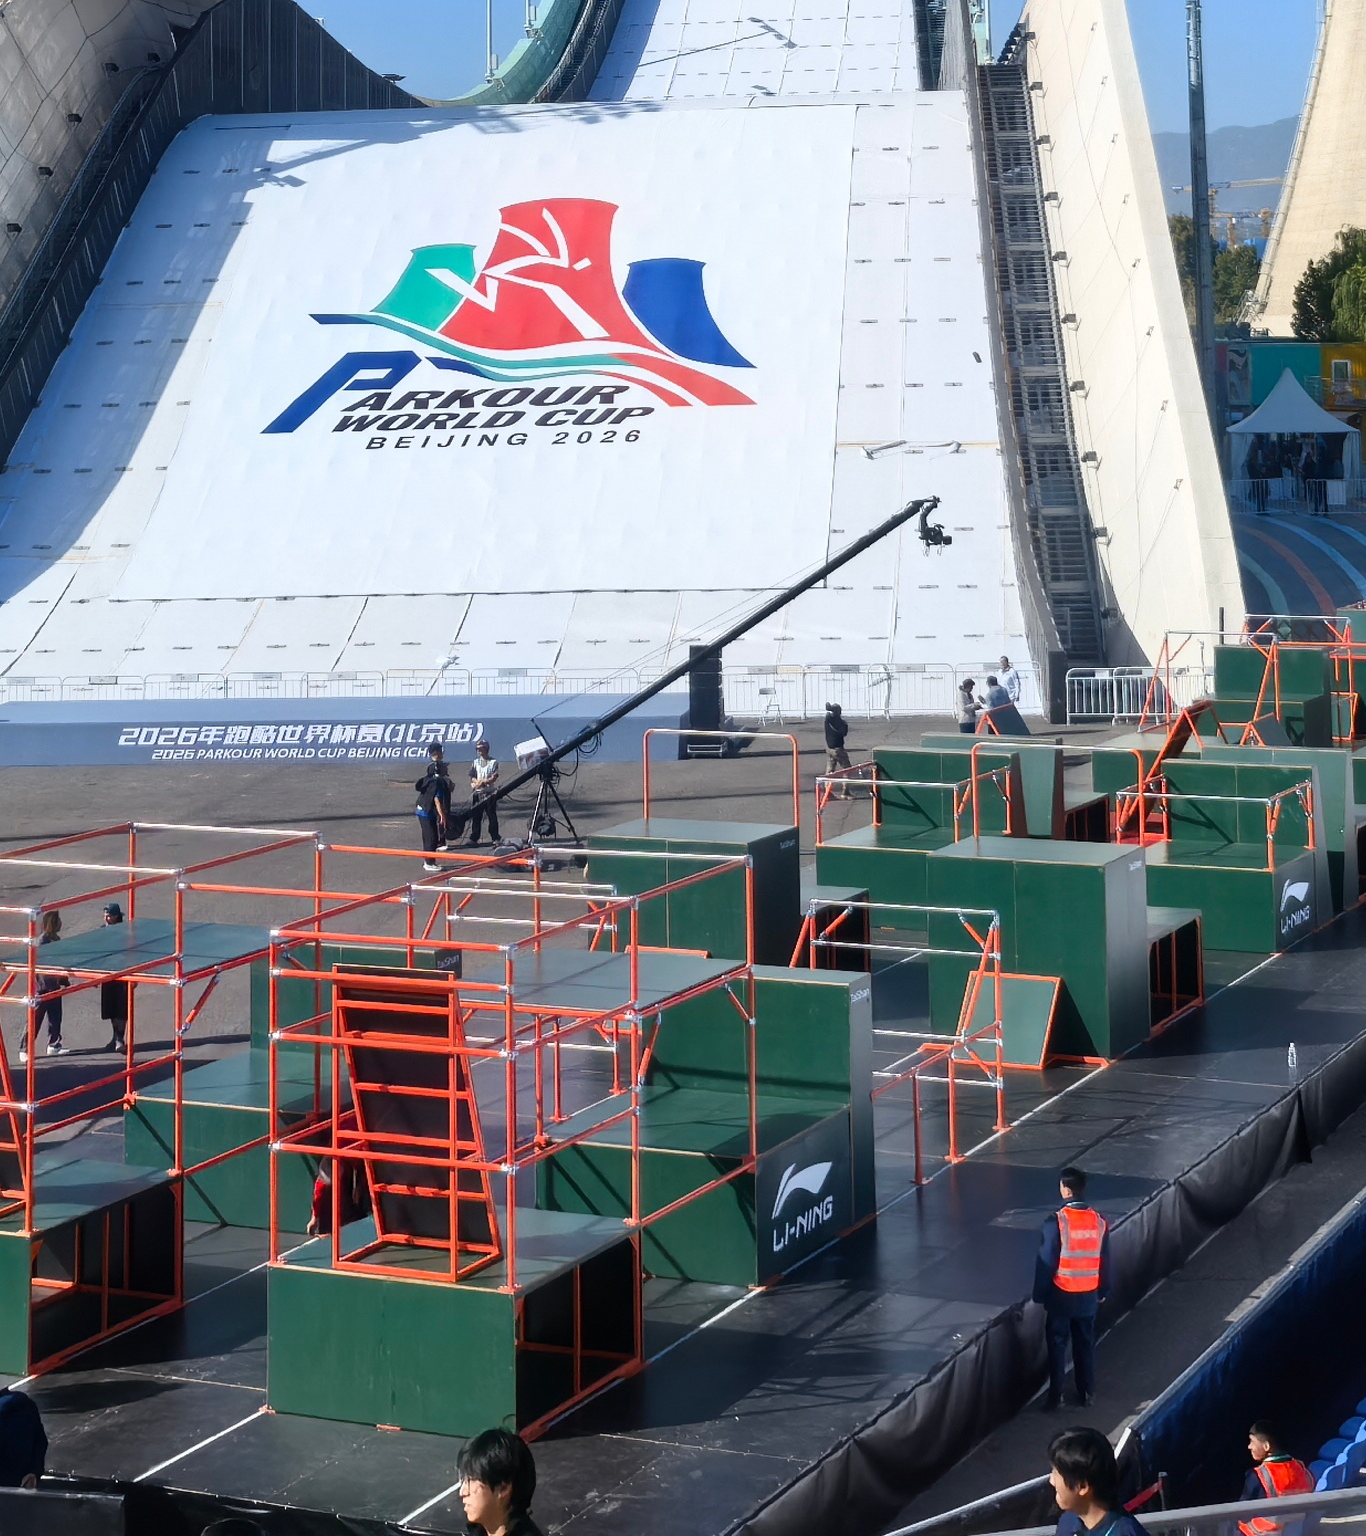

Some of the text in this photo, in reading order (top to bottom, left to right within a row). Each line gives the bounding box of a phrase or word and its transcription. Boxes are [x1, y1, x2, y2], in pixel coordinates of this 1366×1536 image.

[332, 407, 655, 433] WORLD CUP
[365, 429, 641, 450] BEIJING 2026
[152, 749, 195, 760] 2026
[196, 748, 262, 759] PARKOUR
[264, 748, 315, 759] WORLD
[318, 748, 346, 758] CUP
[348, 747, 401, 758] BEIJING
[773, 1195, 833, 1252] LI-NING
